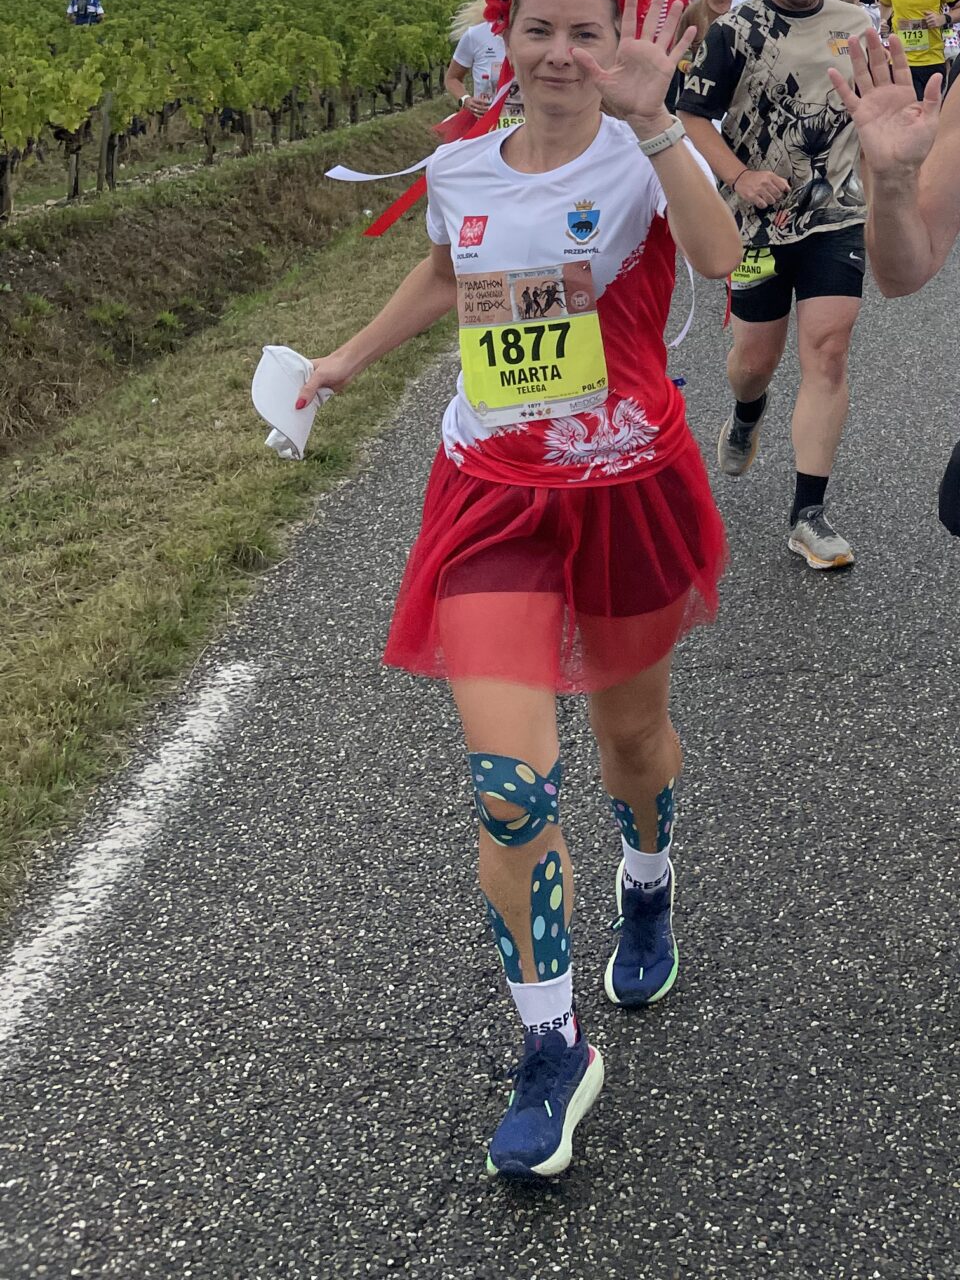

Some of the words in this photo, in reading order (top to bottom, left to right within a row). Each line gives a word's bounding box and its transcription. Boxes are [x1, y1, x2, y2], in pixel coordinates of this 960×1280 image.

[902, 31, 924, 40] 1713
[735, 265, 761, 274] TRAND
[464, 278, 503, 291] MARATHON
[464, 301, 474, 312] DU
[479, 322, 571, 367] 1877
[500, 364, 562, 387] MARTA
[517, 383, 547, 395] TELEGA
[582, 383, 597, 393] POL
